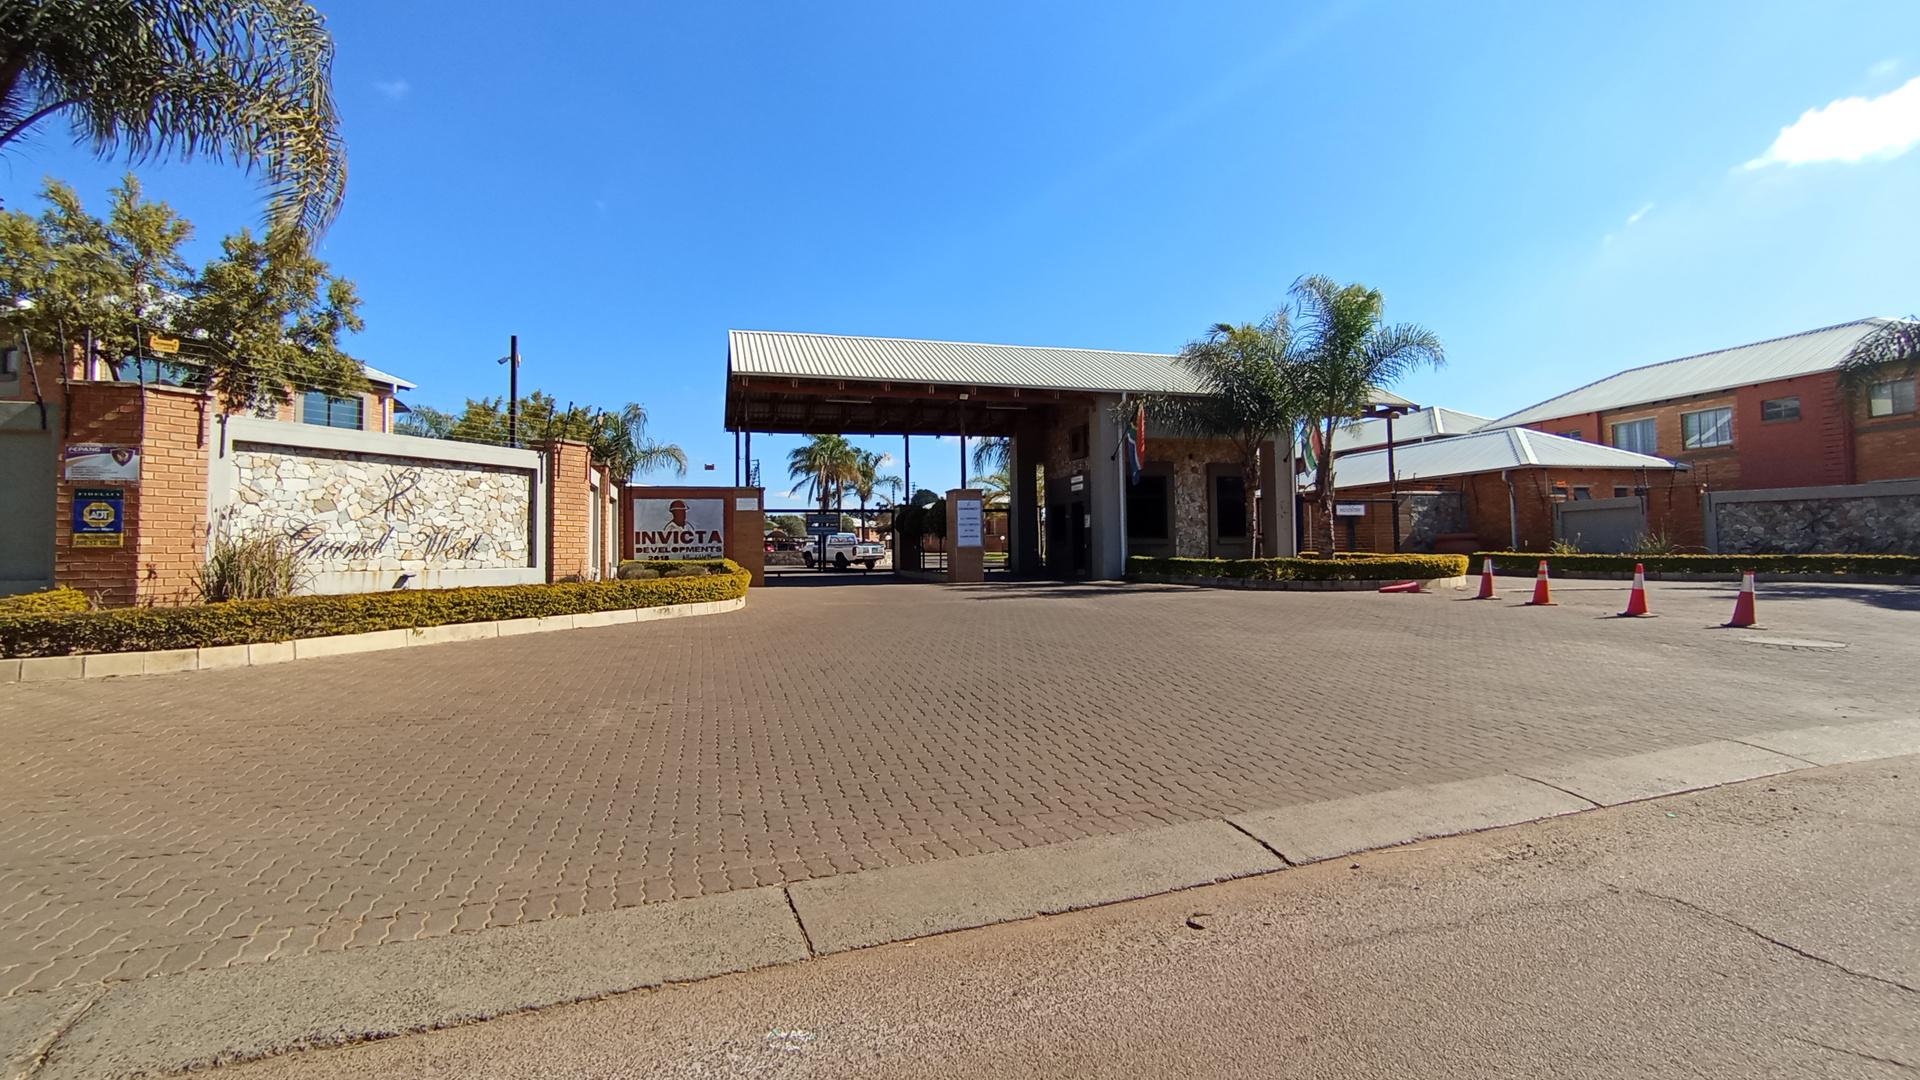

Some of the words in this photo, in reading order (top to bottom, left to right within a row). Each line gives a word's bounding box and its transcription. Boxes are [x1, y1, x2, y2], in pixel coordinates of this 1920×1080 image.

[90, 510, 109, 519] ADT
[279, 515, 394, 559] Grand
[414, 525, 482, 562] West
[635, 531, 722, 544] INVICTA
